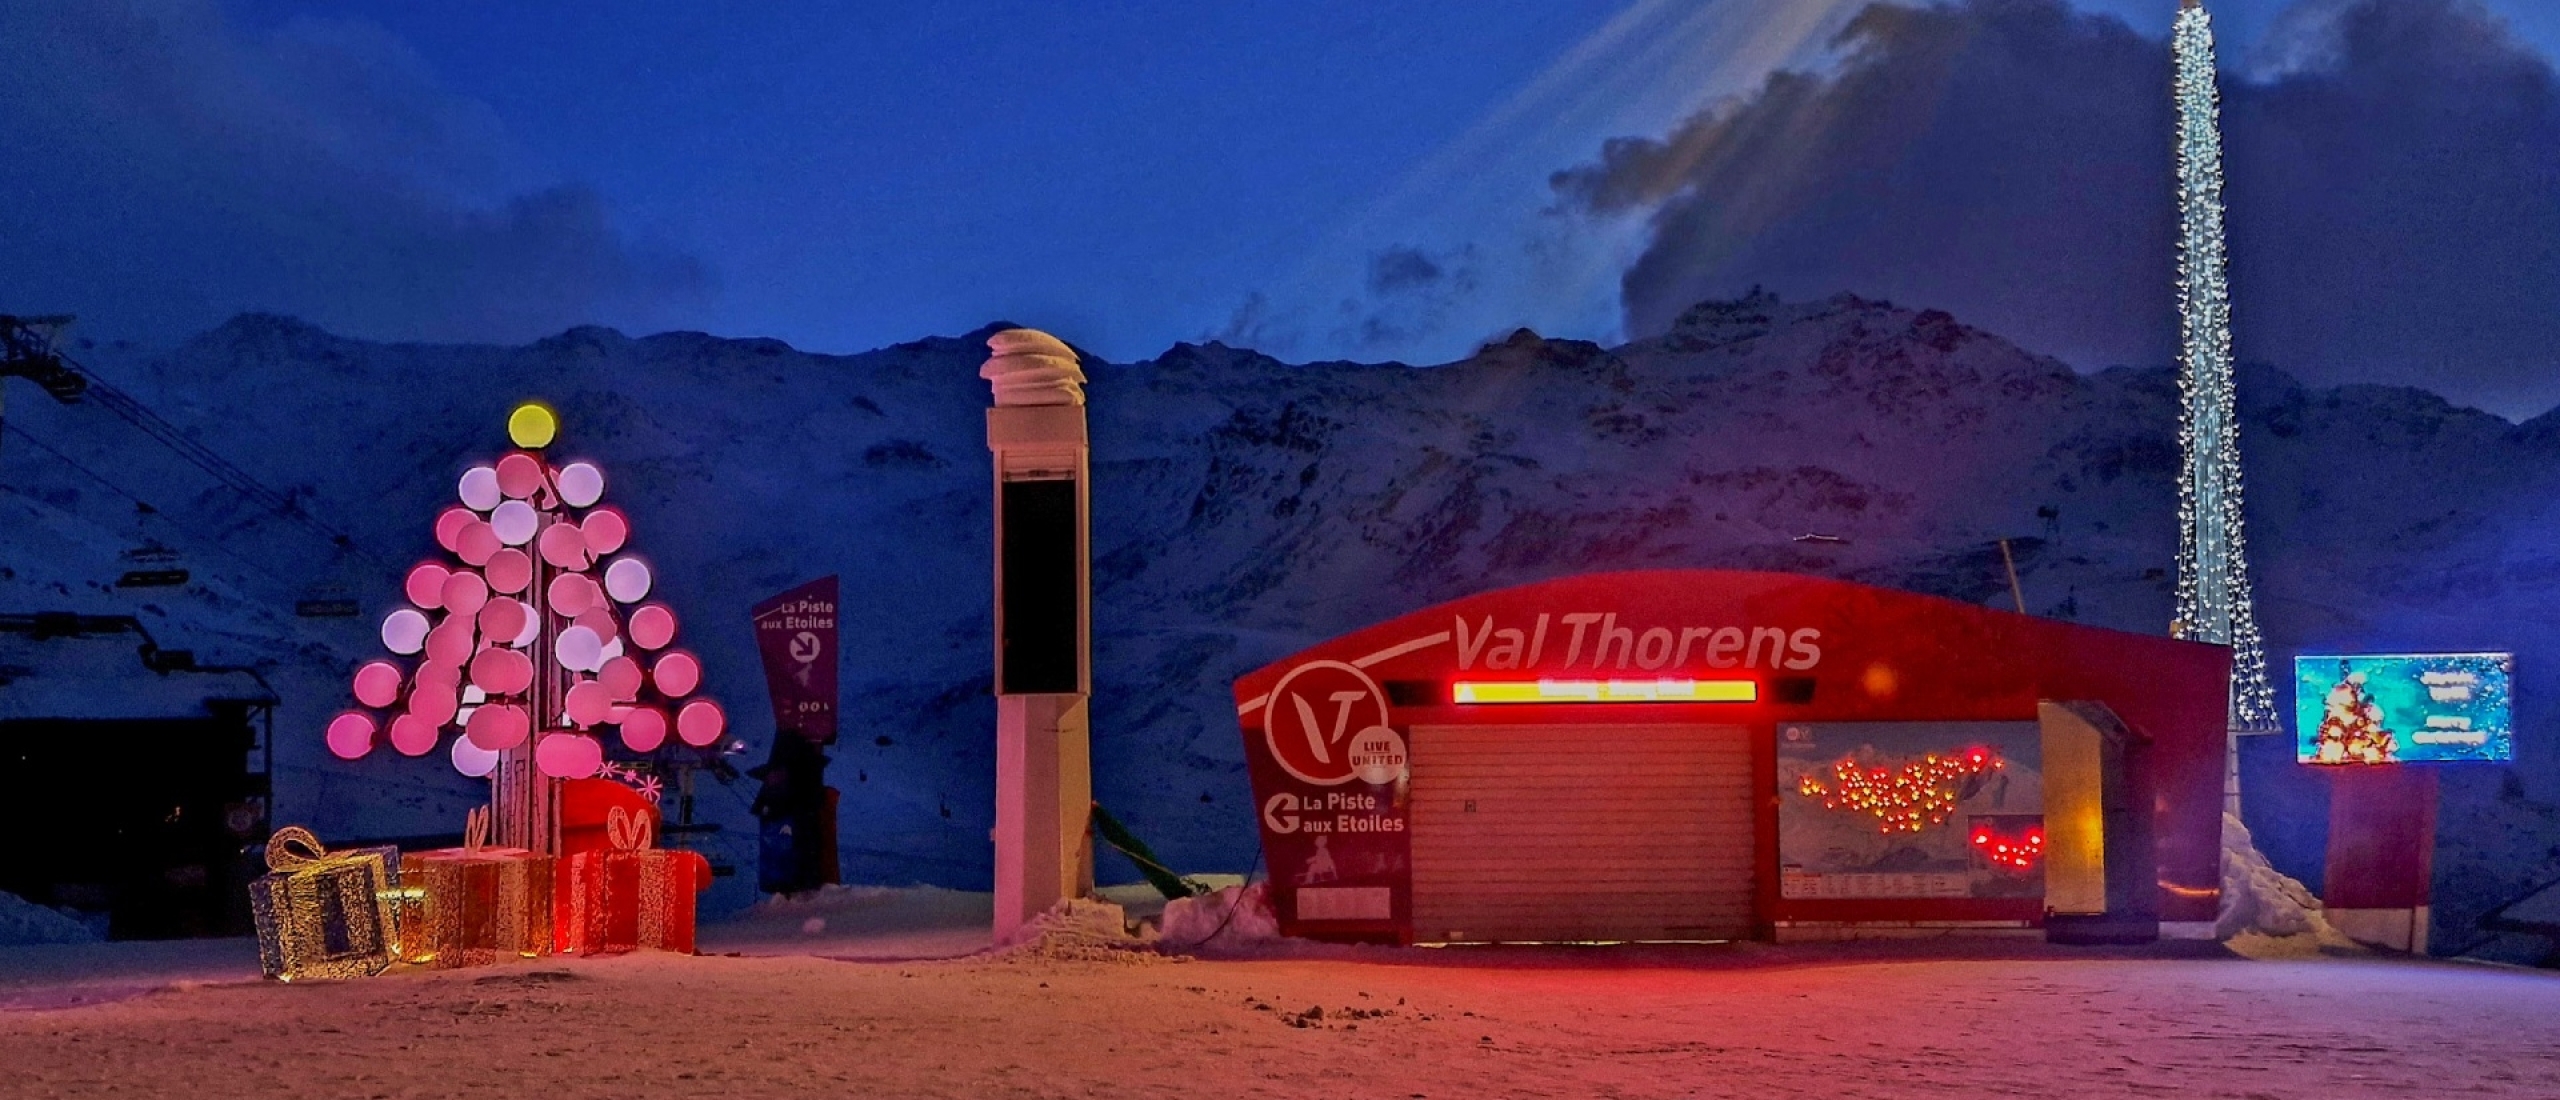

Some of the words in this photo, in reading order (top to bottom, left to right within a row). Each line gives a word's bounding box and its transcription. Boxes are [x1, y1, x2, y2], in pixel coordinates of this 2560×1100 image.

[782, 603, 796, 613] La
[799, 600, 834, 613] Piste
[761, 621, 782, 629] aux
[786, 615, 834, 629] Etoiles
[1455, 612, 1550, 670] Val
[1561, 612, 1821, 670] Thorens
[1364, 741, 1390, 751] LIVE
[1352, 755, 1403, 766] UNITED
[1303, 796, 1323, 810] La
[1327, 793, 1376, 810] Piste
[1303, 820, 1333, 833] aux
[1337, 814, 1405, 833] Etoiles
